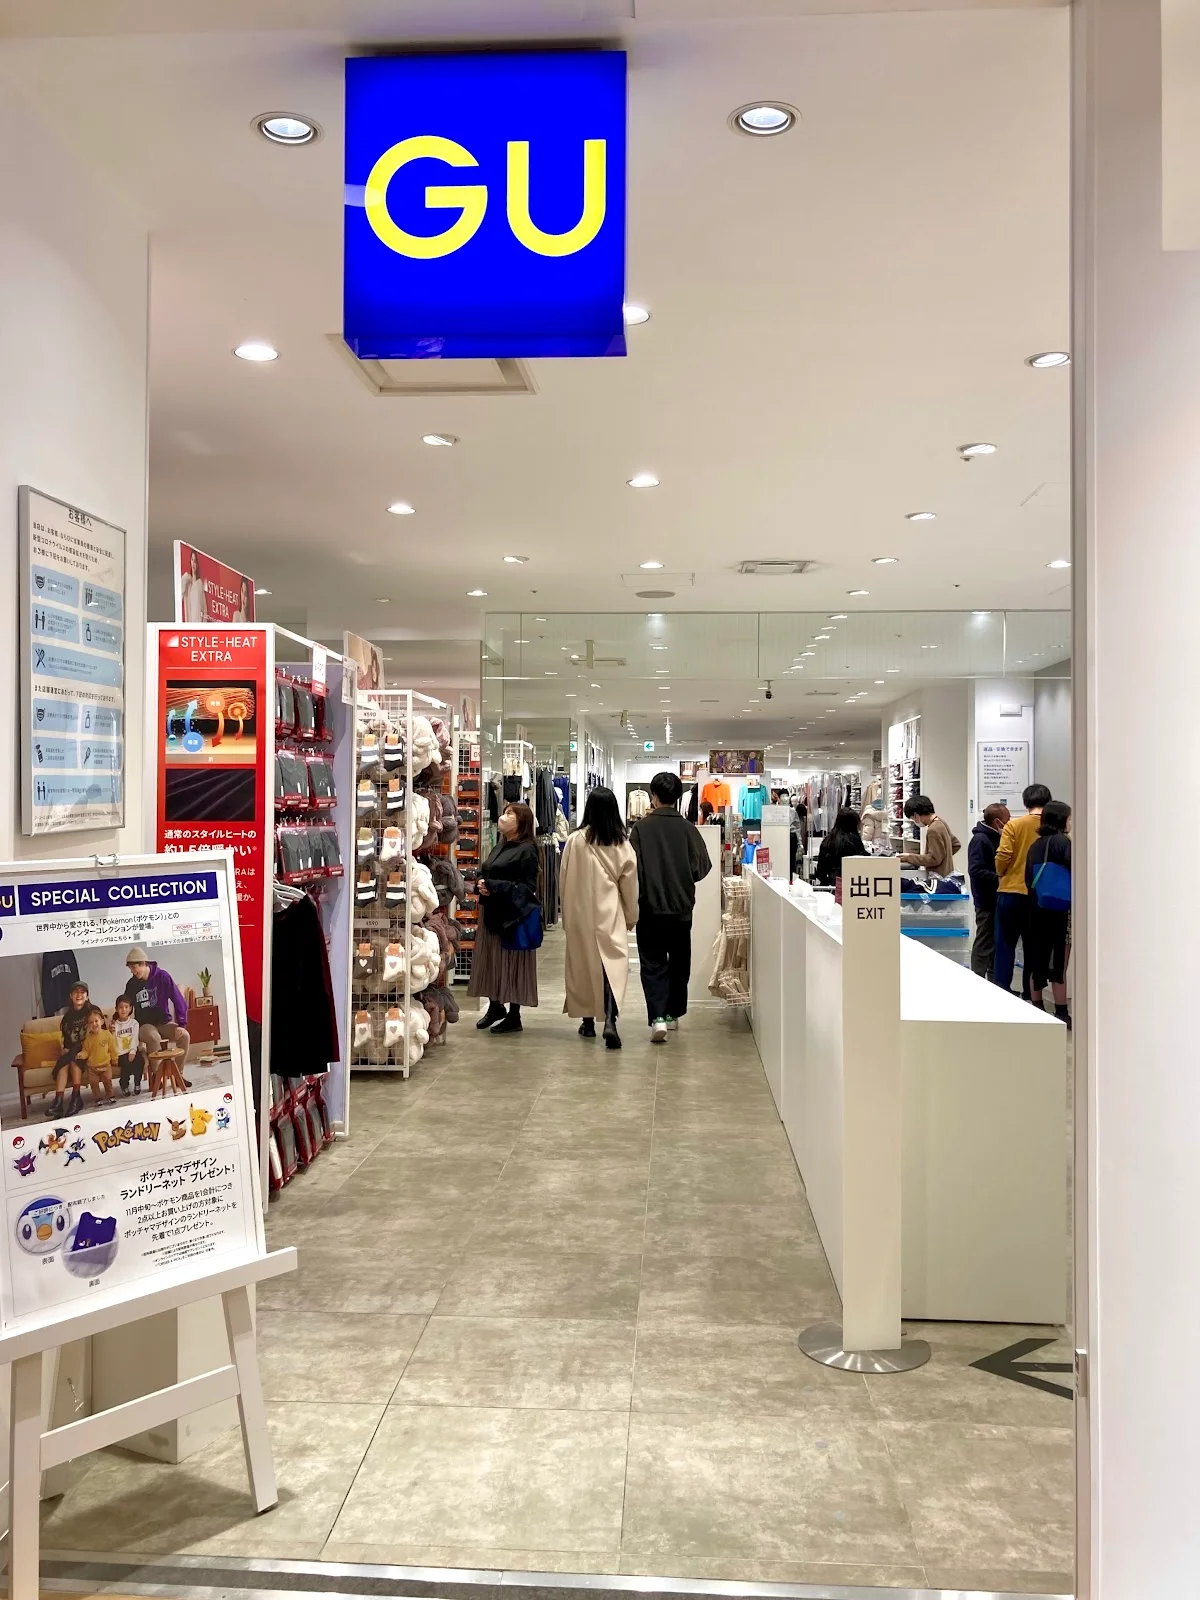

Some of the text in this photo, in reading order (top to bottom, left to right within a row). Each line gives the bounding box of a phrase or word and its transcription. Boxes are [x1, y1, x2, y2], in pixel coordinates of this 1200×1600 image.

[364, 135, 606, 259] GU
[68, 508, 91, 526] お客様へ
[208, 581, 239, 606] STYLE-HEAT
[211, 600, 230, 619] EXTRA
[181, 636, 258, 648] STYLE-HEAT
[191, 651, 233, 662] EXTRA
[164, 829, 257, 839] 通常のスタイルヒートの
[0, 879, 208, 909] U SPECIAL COLLECTION
[850, 875, 893, 898] 出口
[857, 907, 886, 920] EXIT
[140, 1157, 217, 1183] ポッチャマデザイン
[120, 1176, 186, 1200] ランドリーネット
[124, 1201, 238, 1238] ポッチャマデザインのランドリーネットを
[137, 1195, 224, 1224] 2点以上お買い上げの方対象に
[151, 1220, 214, 1242] 先着で1点プレゼント。
